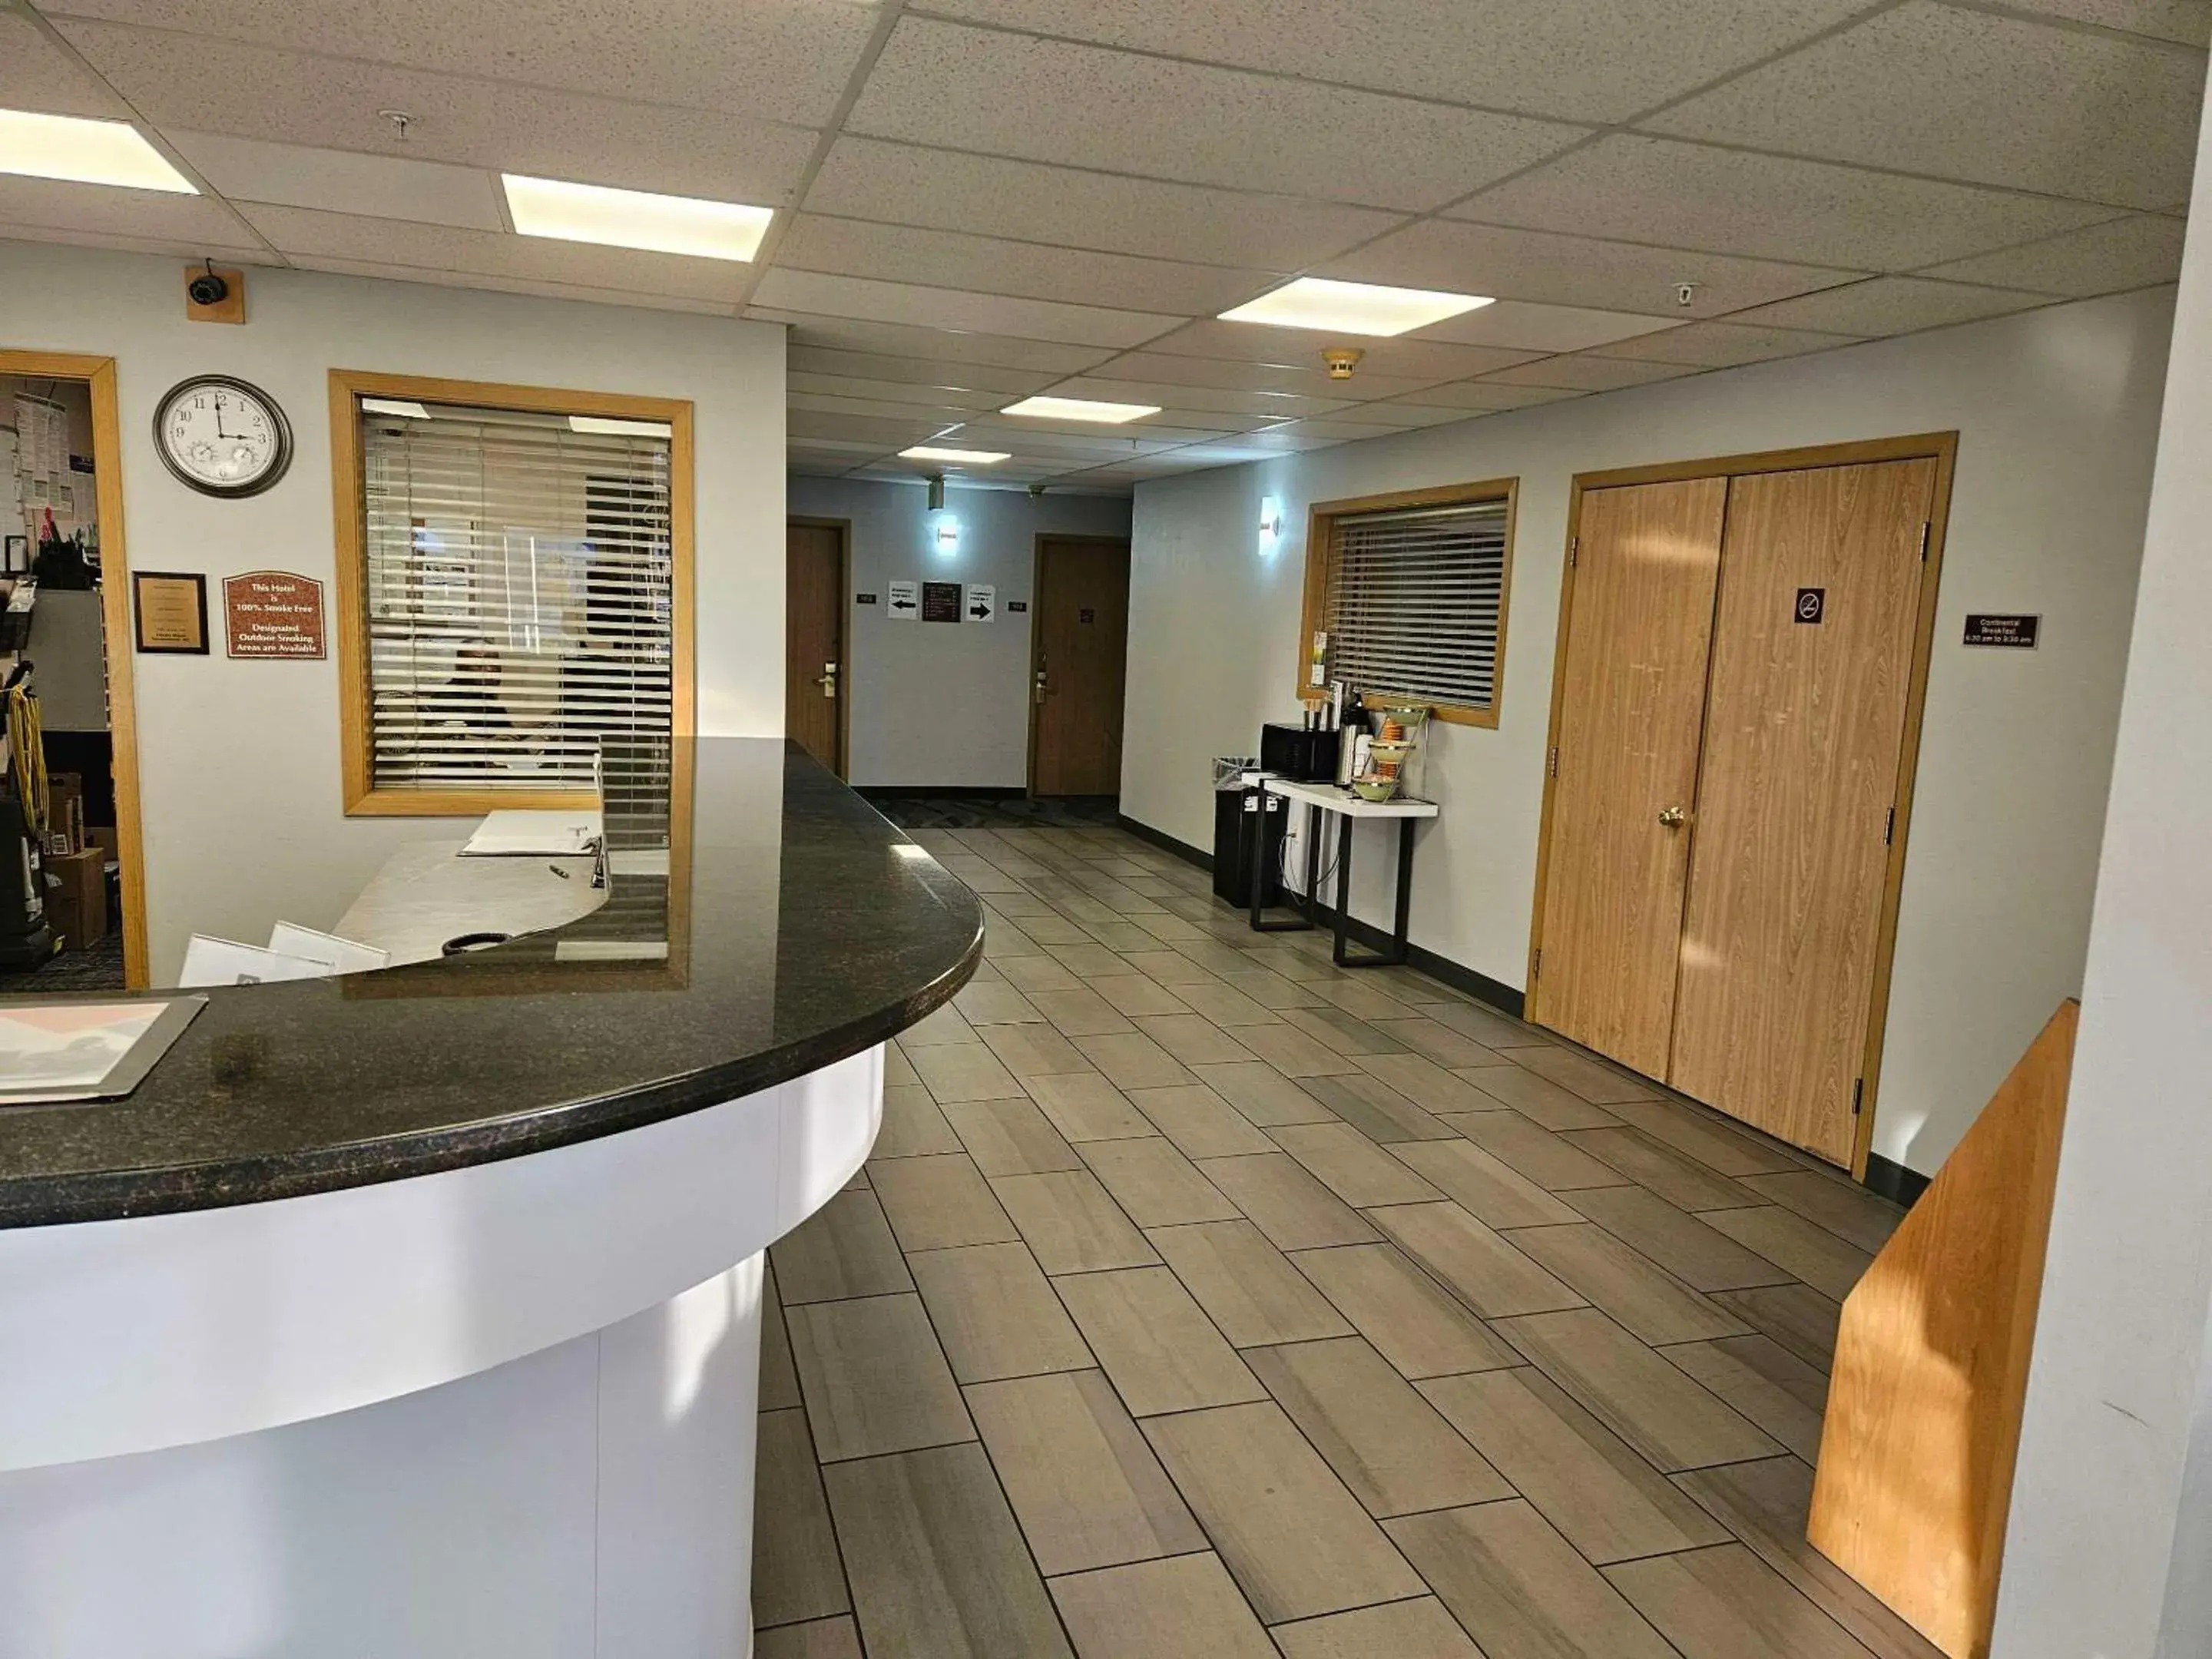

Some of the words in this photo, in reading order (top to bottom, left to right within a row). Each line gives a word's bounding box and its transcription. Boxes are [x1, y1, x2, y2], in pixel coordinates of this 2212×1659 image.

[194, 398, 204, 409] 11
[240, 401, 245, 412] 1
[180, 411, 192, 422] 10
[253, 416, 261, 427] 2
[176, 427, 184, 437] 9
[257, 432, 266, 444] 3
[252, 584, 270, 592] This
[271, 584, 296, 593] Hotel
[270, 593, 278, 602] is
[237, 603, 262, 611] 100%
[264, 604, 293, 612] Smoke
[294, 604, 313, 613] Free
[252, 624, 299, 633] Designated
[239, 633, 275, 641] Outdoor
[277, 634, 313, 644] Smoking
[278, 644, 316, 653] Available
